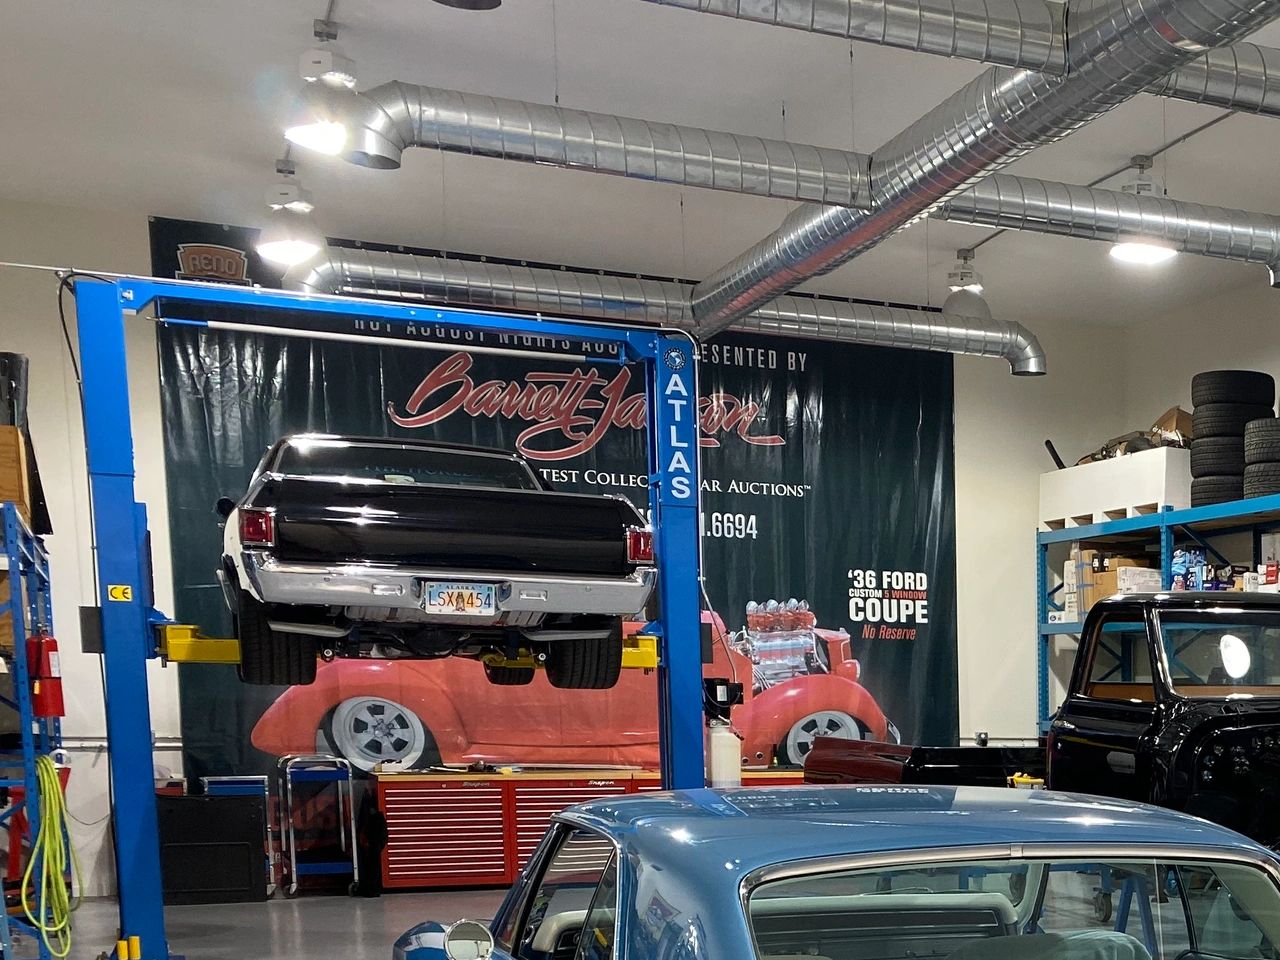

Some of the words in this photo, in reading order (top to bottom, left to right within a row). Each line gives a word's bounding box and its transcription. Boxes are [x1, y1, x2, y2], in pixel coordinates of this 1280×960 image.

[700, 343, 777, 369] ESENTED
[787, 351, 807, 372] BY
[664, 373, 692, 499] ATLAS
[540, 468, 580, 483] TEST
[584, 469, 649, 488] COLLEC
[701, 479, 722, 493] AR
[700, 511, 758, 539] 1.6694
[848, 588, 882, 598] CUSTOM
[884, 590, 890, 598] 5
[891, 590, 927, 600] WINDOW
[882, 571, 928, 591] FORD
[849, 597, 929, 624] COUPE
[862, 624, 876, 639] No
[878, 625, 917, 640] Reserve
